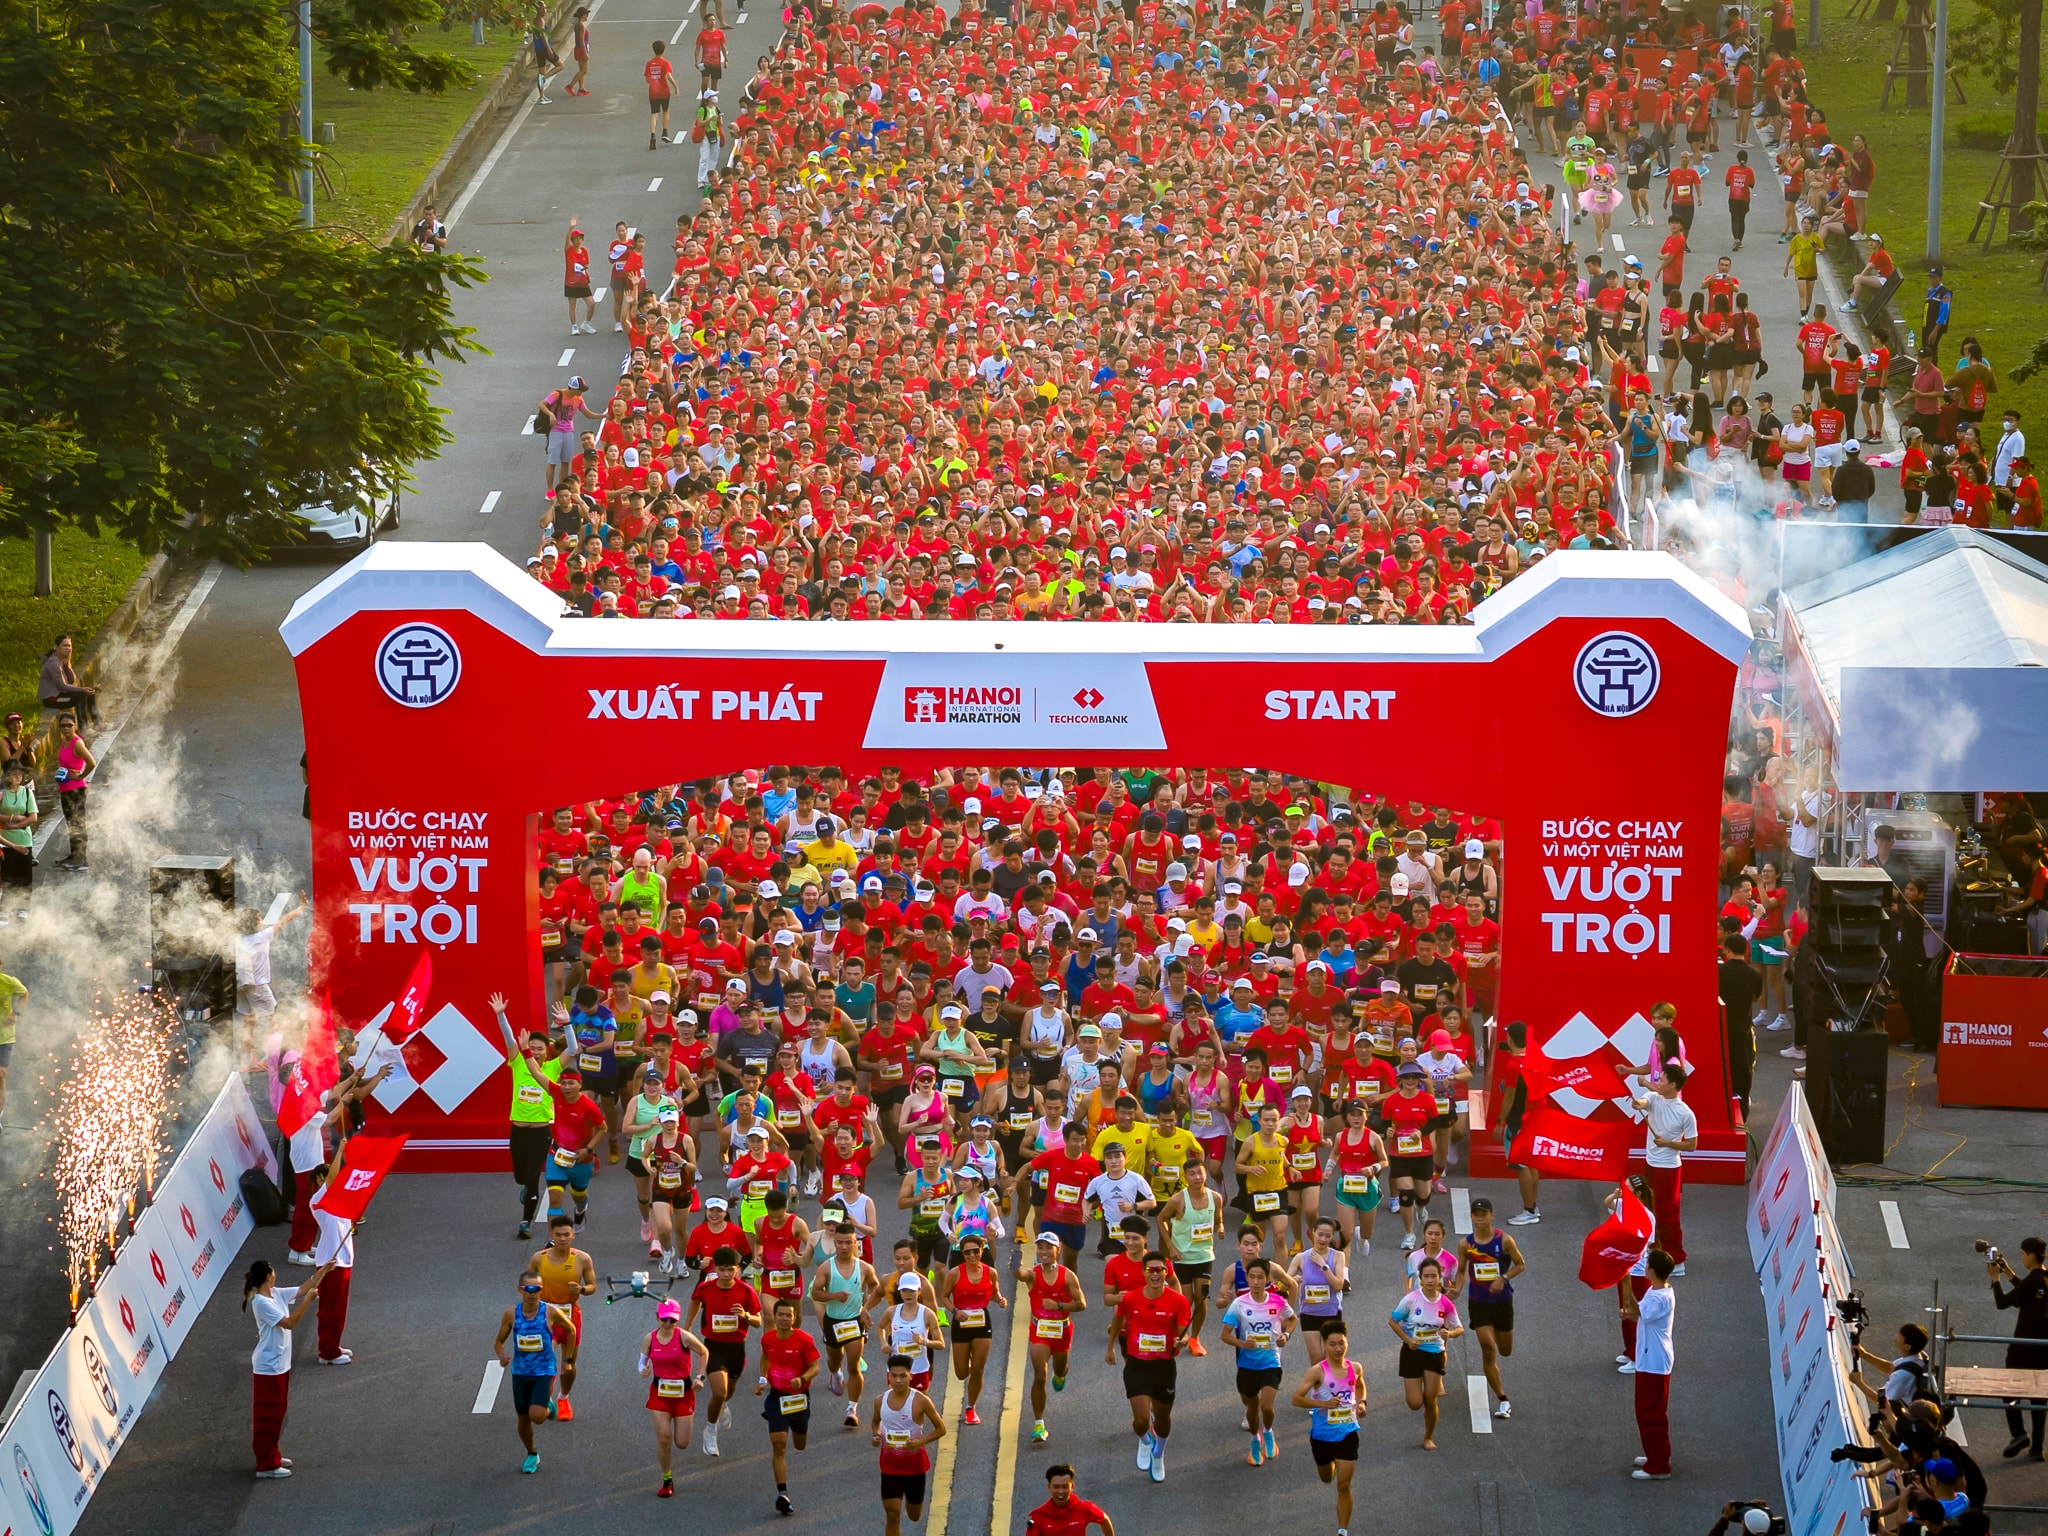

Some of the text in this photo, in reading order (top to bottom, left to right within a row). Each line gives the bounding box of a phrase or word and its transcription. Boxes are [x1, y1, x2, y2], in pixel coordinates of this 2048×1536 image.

[408, 694, 418, 704] HÀ
[588, 682, 823, 721] XUẤT PHÁT
[949, 687, 1021, 705] HANOI
[1264, 689, 1396, 720] START
[1605, 703, 1615, 713] HÀ
[949, 712, 1021, 724] MARATHON
[1049, 715, 1128, 724] TECHCOMBANK
[348, 808, 488, 834] BƯỚC CHẠY
[1542, 816, 1683, 842] BƯỚC CHẠY
[348, 833, 489, 851] VÌ MỘT VIỆT NAM
[1542, 841, 1683, 861] VÌ MỘT VIỆT NAM
[348, 851, 488, 900] VƯỢT
[1542, 860, 1682, 910] VƯỢT
[349, 898, 478, 951] TRỘI
[1541, 905, 1671, 961] TRỘI
[1167, 1010, 1185, 1020] US
[1968, 1023, 2013, 1036] HANOI
[1968, 1038, 2012, 1047] MARATHON
[1559, 1142, 1604, 1157] HANOI
[1248, 1321, 1273, 1332] YPR
